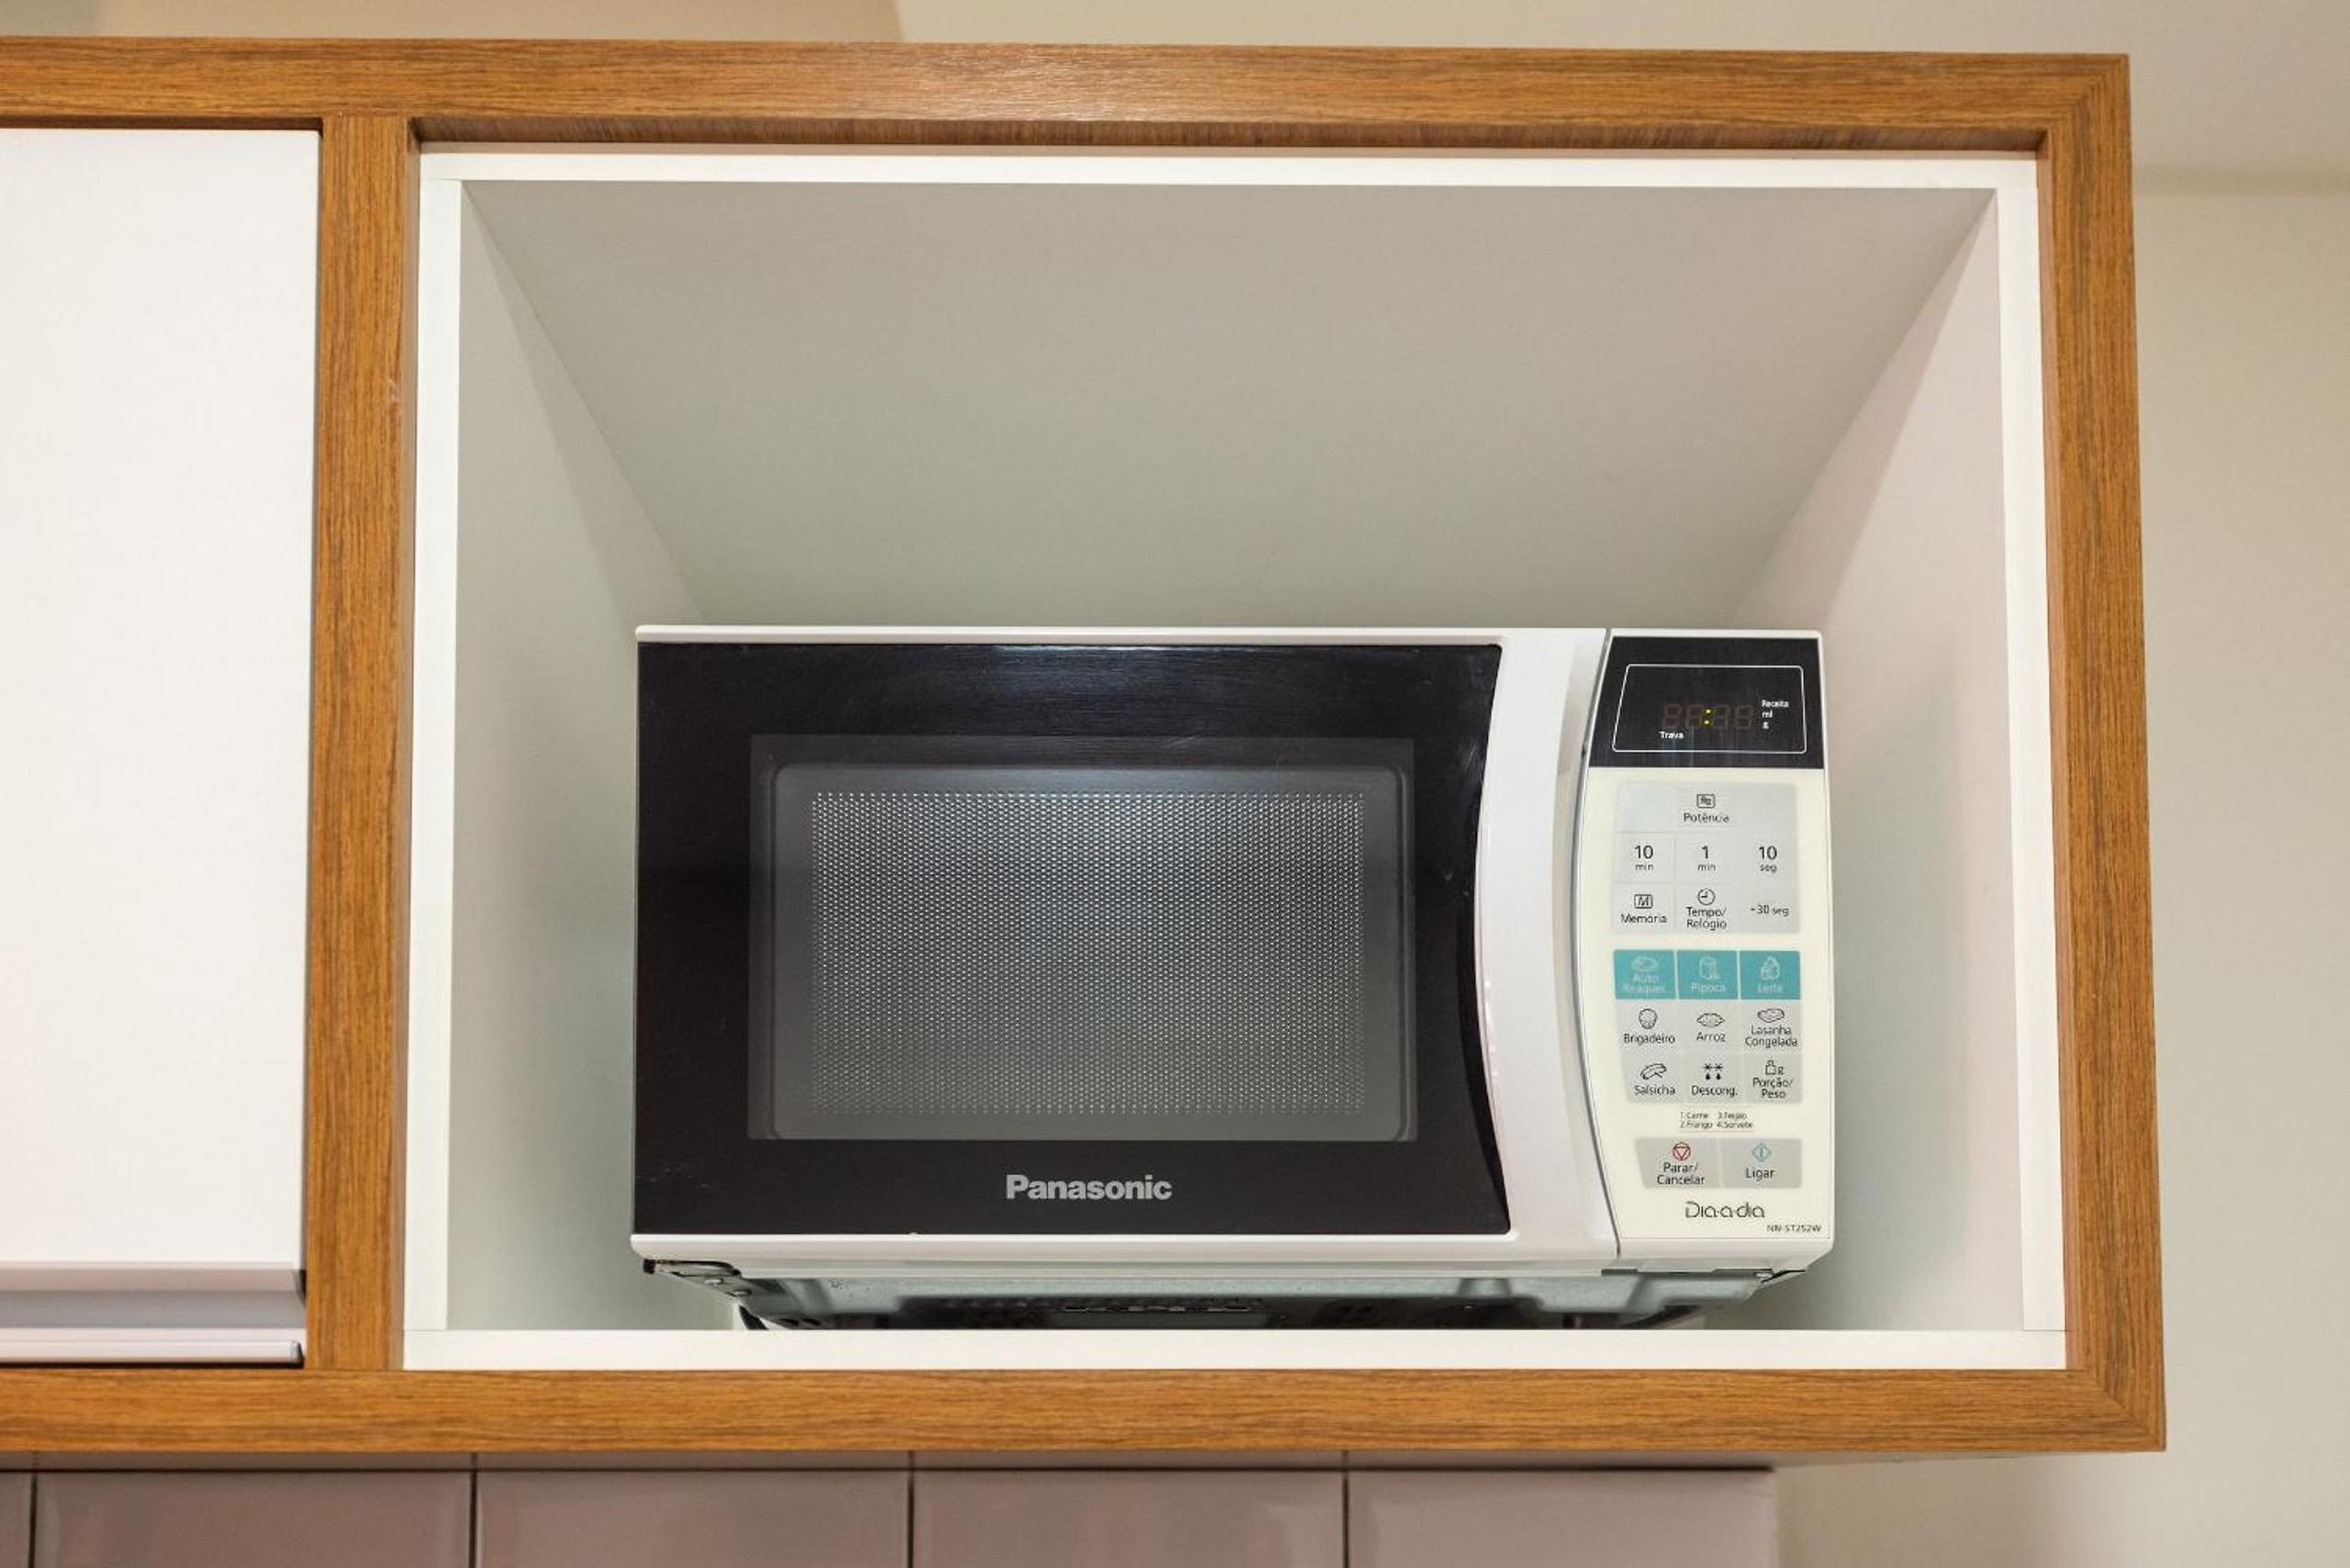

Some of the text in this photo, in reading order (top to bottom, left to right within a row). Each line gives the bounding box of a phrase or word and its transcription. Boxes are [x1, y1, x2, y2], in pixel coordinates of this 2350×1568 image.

[1761, 700, 1790, 708] Receita
[1762, 710, 1774, 718] ml
[1660, 731, 1684, 739] Trava
[1683, 812, 1729, 823] Potência
[1635, 846, 1653, 859] 10
[1701, 846, 1709, 859] 1
[1759, 846, 1778, 860] 10
[1635, 862, 1654, 871] min
[1698, 862, 1716, 871] min
[1759, 863, 1777, 872] seg
[1686, 906, 1727, 918] Tempo/
[1772, 907, 1789, 917] seg
[1621, 913, 1667, 924] Memória
[1686, 918, 1727, 931] Relógio
[1632, 974, 1660, 982] Auto
[1691, 982, 1726, 994] Pipoca
[1757, 983, 1785, 993] Leite
[1751, 1025, 1791, 1036] Lasanha
[1624, 1033, 1675, 1046] Brigadeiro
[1696, 1032, 1726, 1042] Arroz
[1745, 1036, 1798, 1048] Congelada
[1634, 1084, 1676, 1096] Salsicha
[1691, 1085, 1738, 1099] Descong.
[1762, 1089, 1786, 1099] Peso
[1663, 1162, 1698, 1173] Parar/
[1657, 1174, 1705, 1185] Cancelar
[1746, 1168, 1775, 1181] Ligar
[1006, 1174, 1172, 1200] Panasonic
